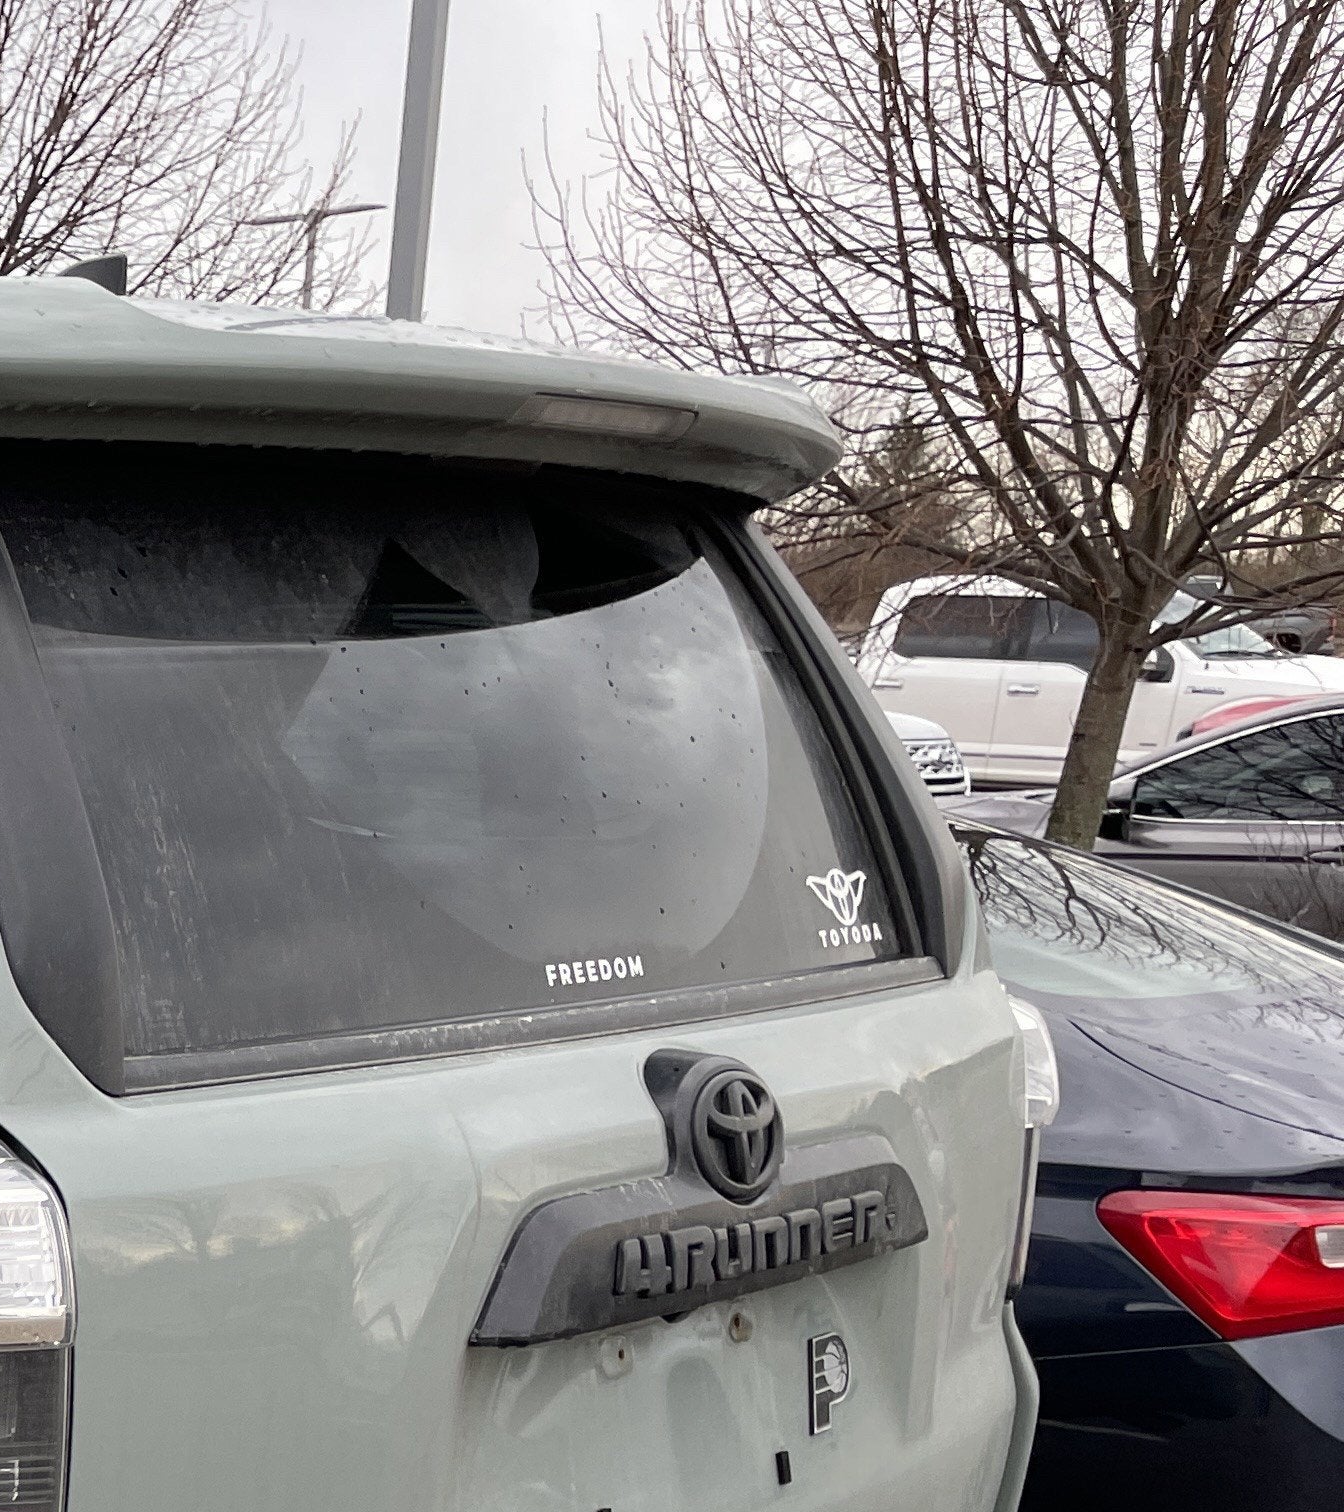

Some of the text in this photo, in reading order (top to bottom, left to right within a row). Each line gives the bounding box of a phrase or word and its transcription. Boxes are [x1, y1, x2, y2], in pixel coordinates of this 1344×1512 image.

[818, 922, 883, 949] TOYODA
[545, 955, 645, 987] FREEDOM
[612, 1190, 888, 1298] 4RUNNER
